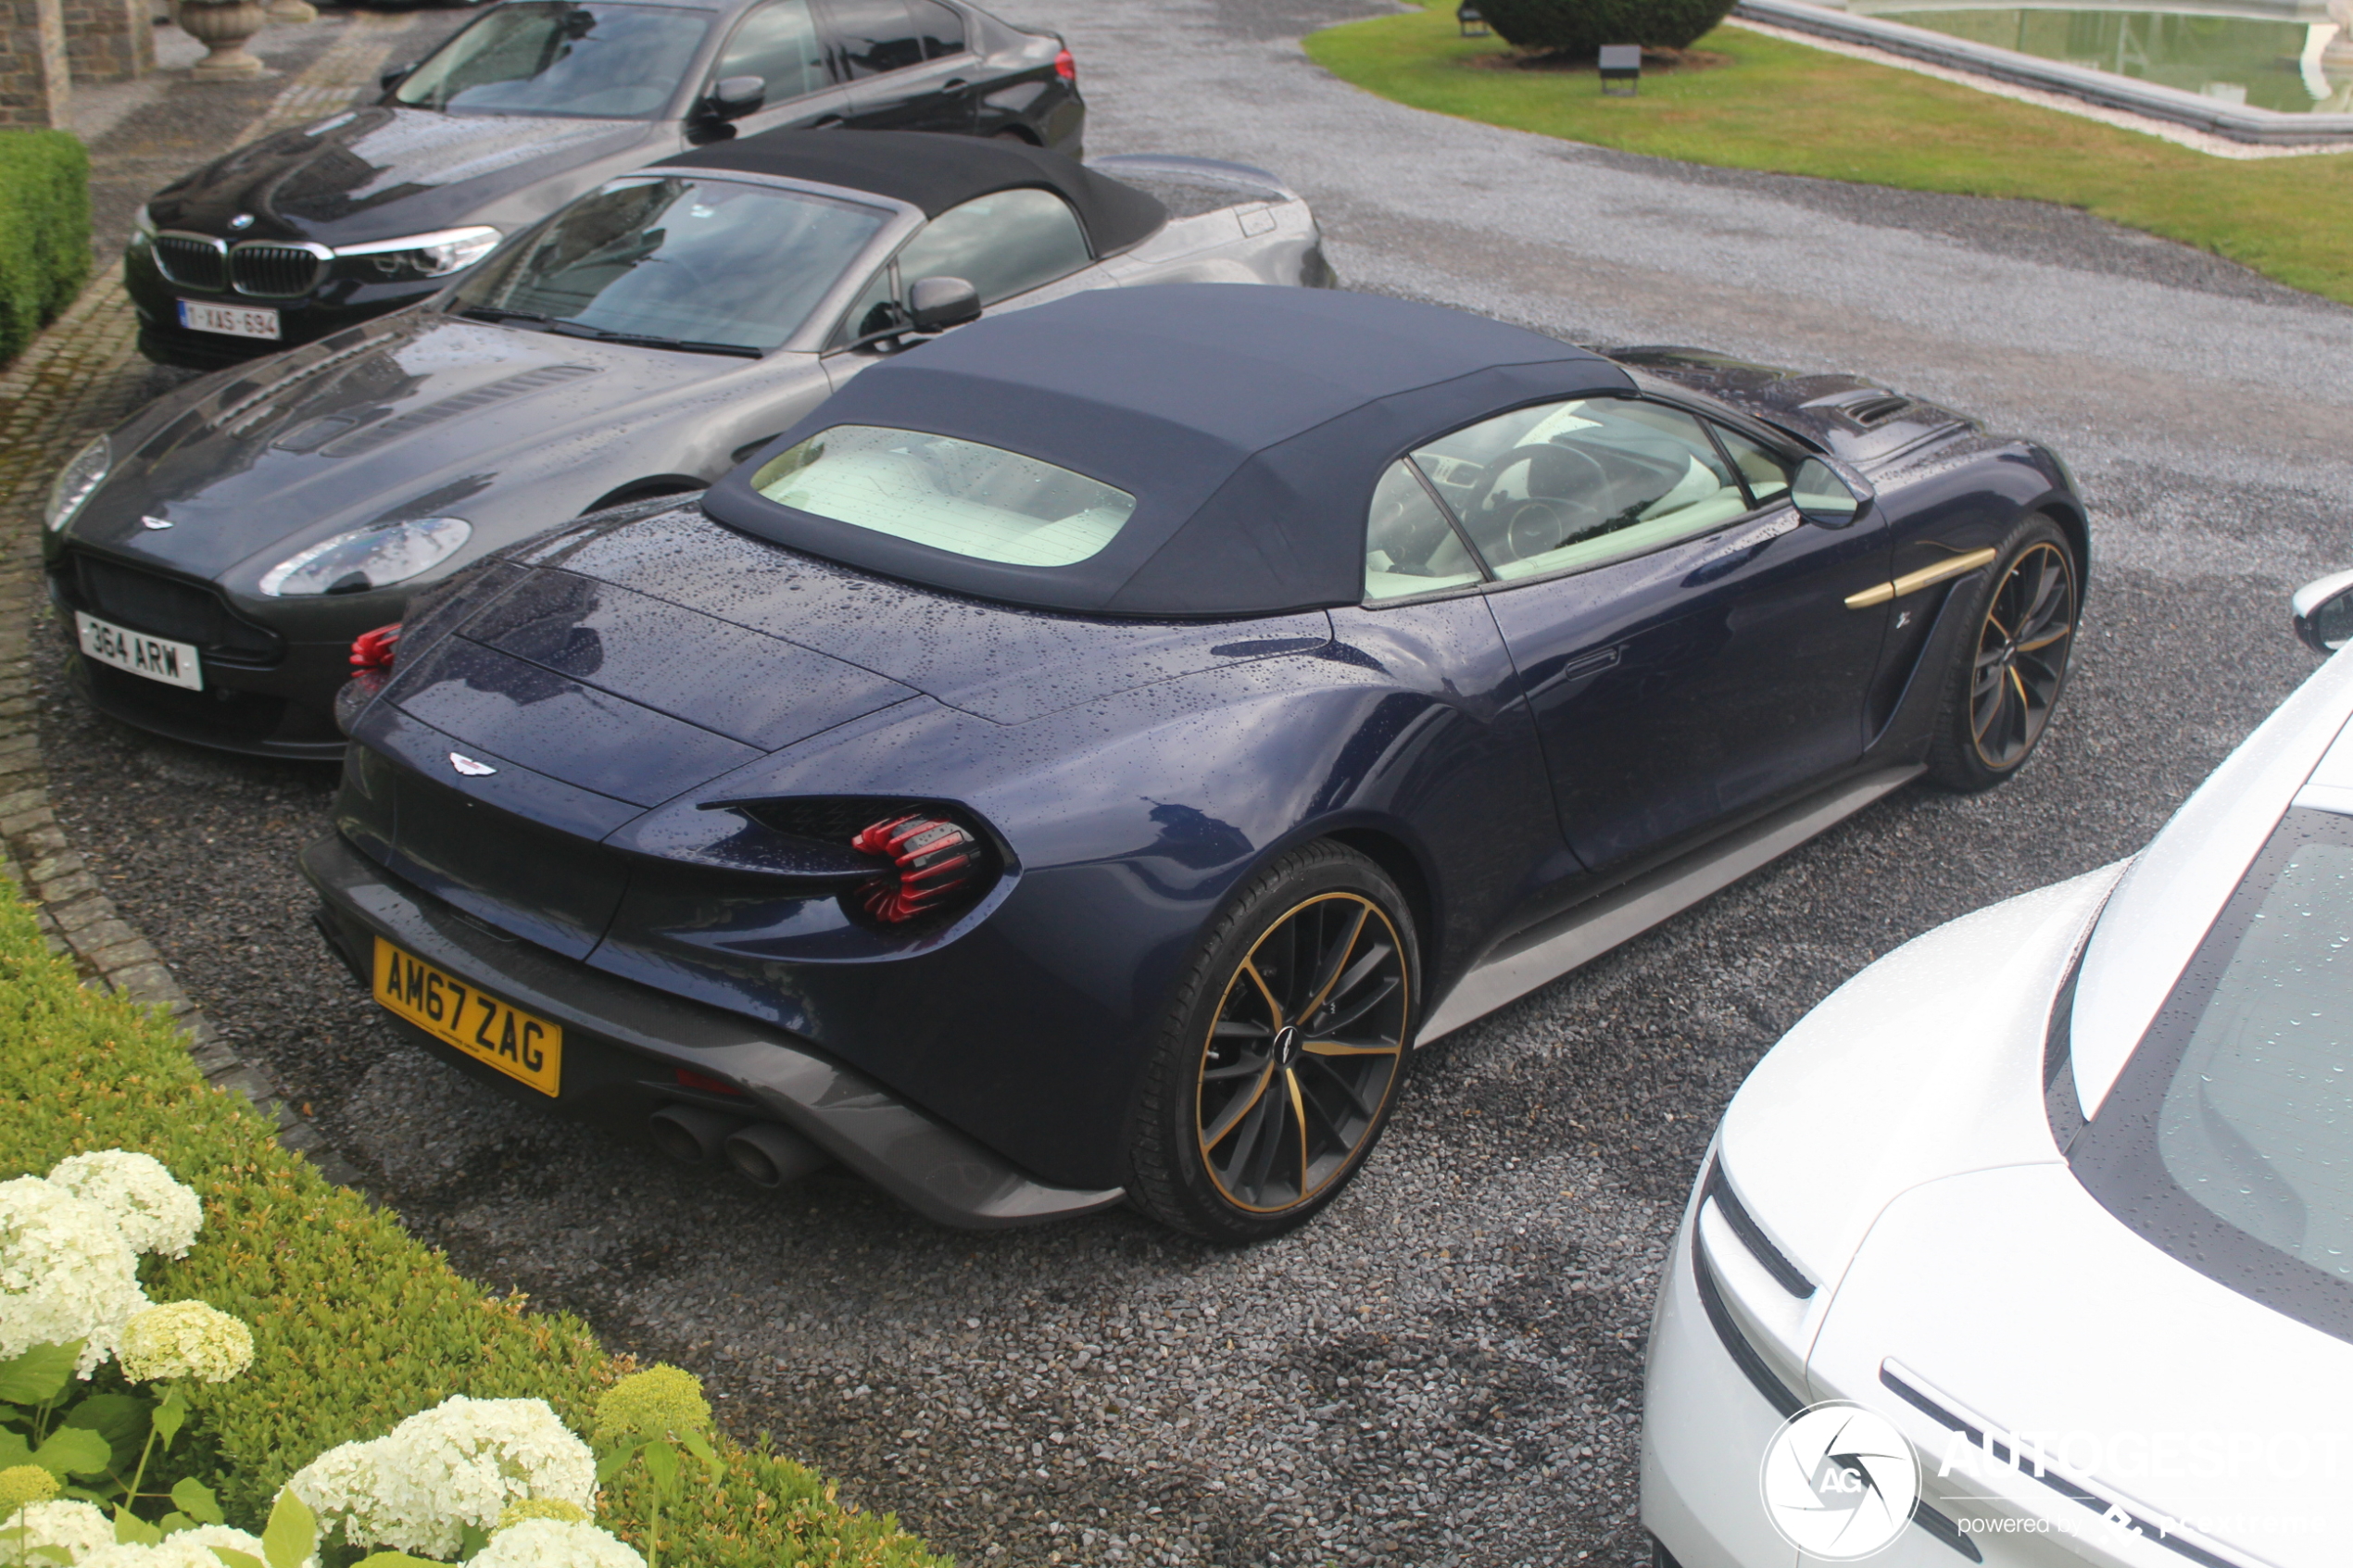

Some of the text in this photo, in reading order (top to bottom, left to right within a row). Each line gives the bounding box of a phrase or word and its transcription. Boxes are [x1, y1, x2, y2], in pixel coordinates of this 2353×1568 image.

[90, 621, 181, 678] 364 ARW
[386, 950, 545, 1073] AM67 ZAG
